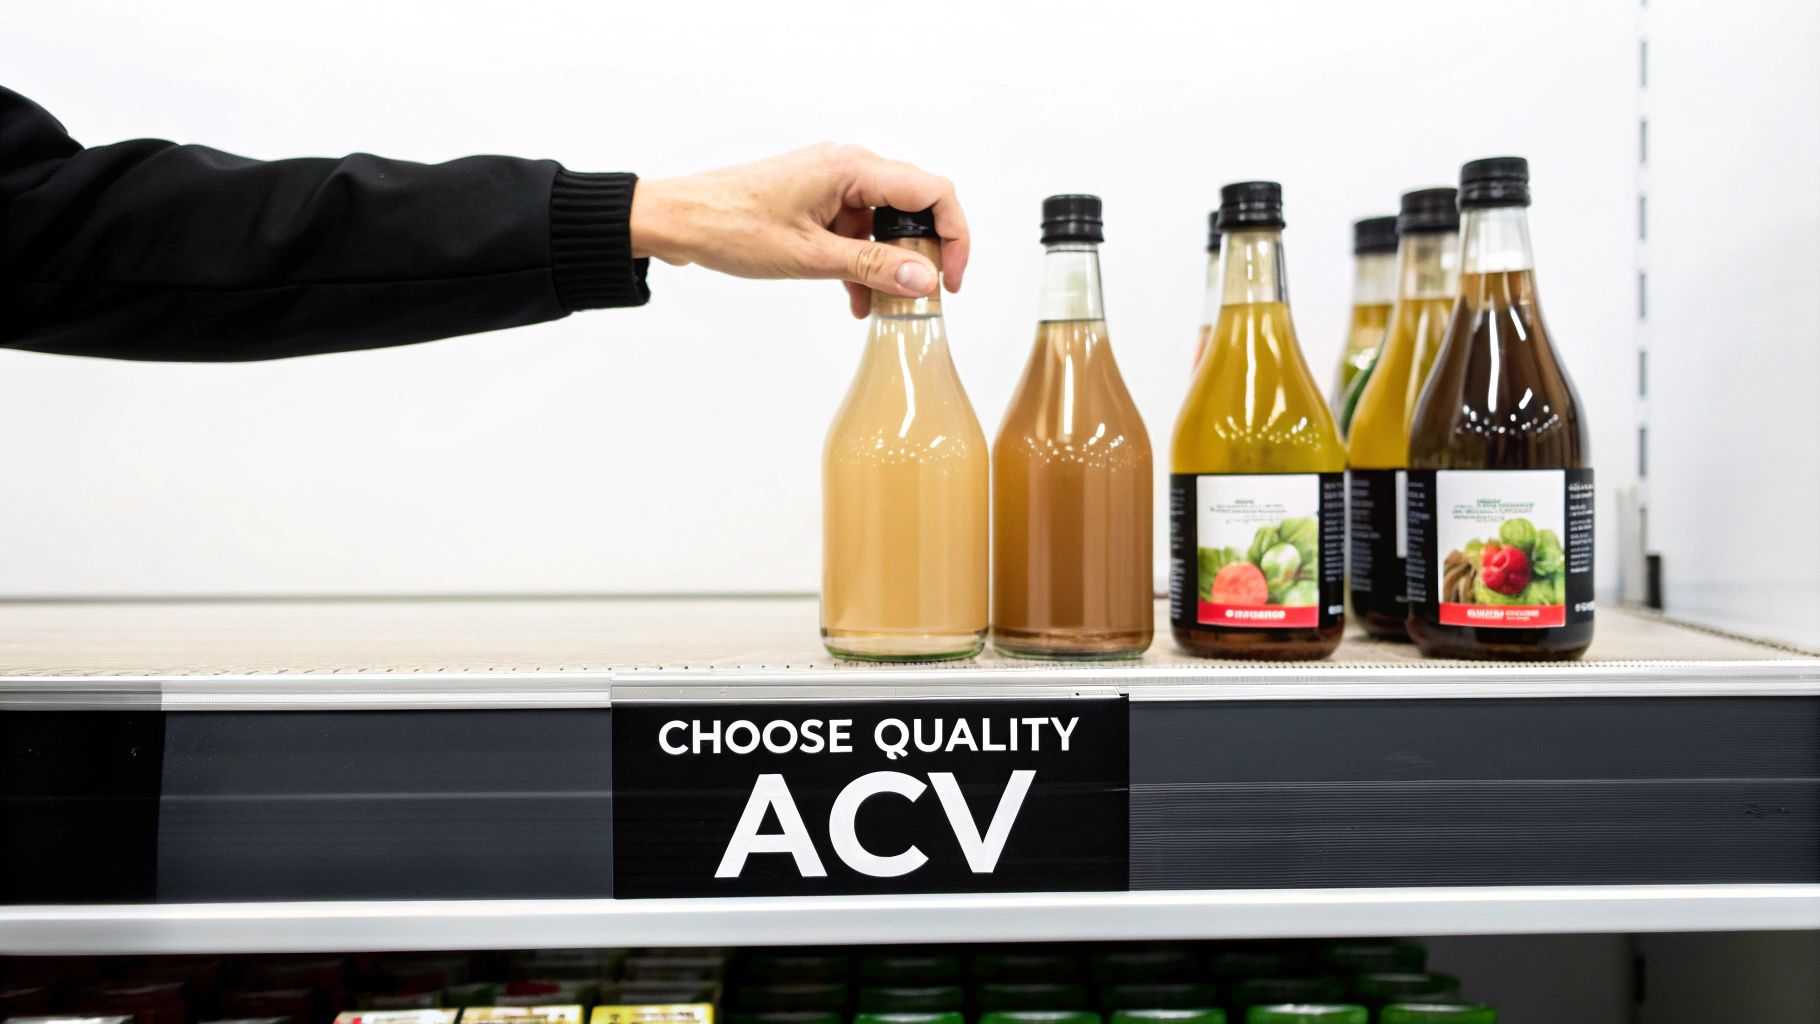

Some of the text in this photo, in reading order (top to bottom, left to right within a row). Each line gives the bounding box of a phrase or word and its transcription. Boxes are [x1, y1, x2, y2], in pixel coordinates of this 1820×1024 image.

[658, 716, 1080, 760] CHOOSE QUALITY
[714, 769, 1037, 879] ACV
